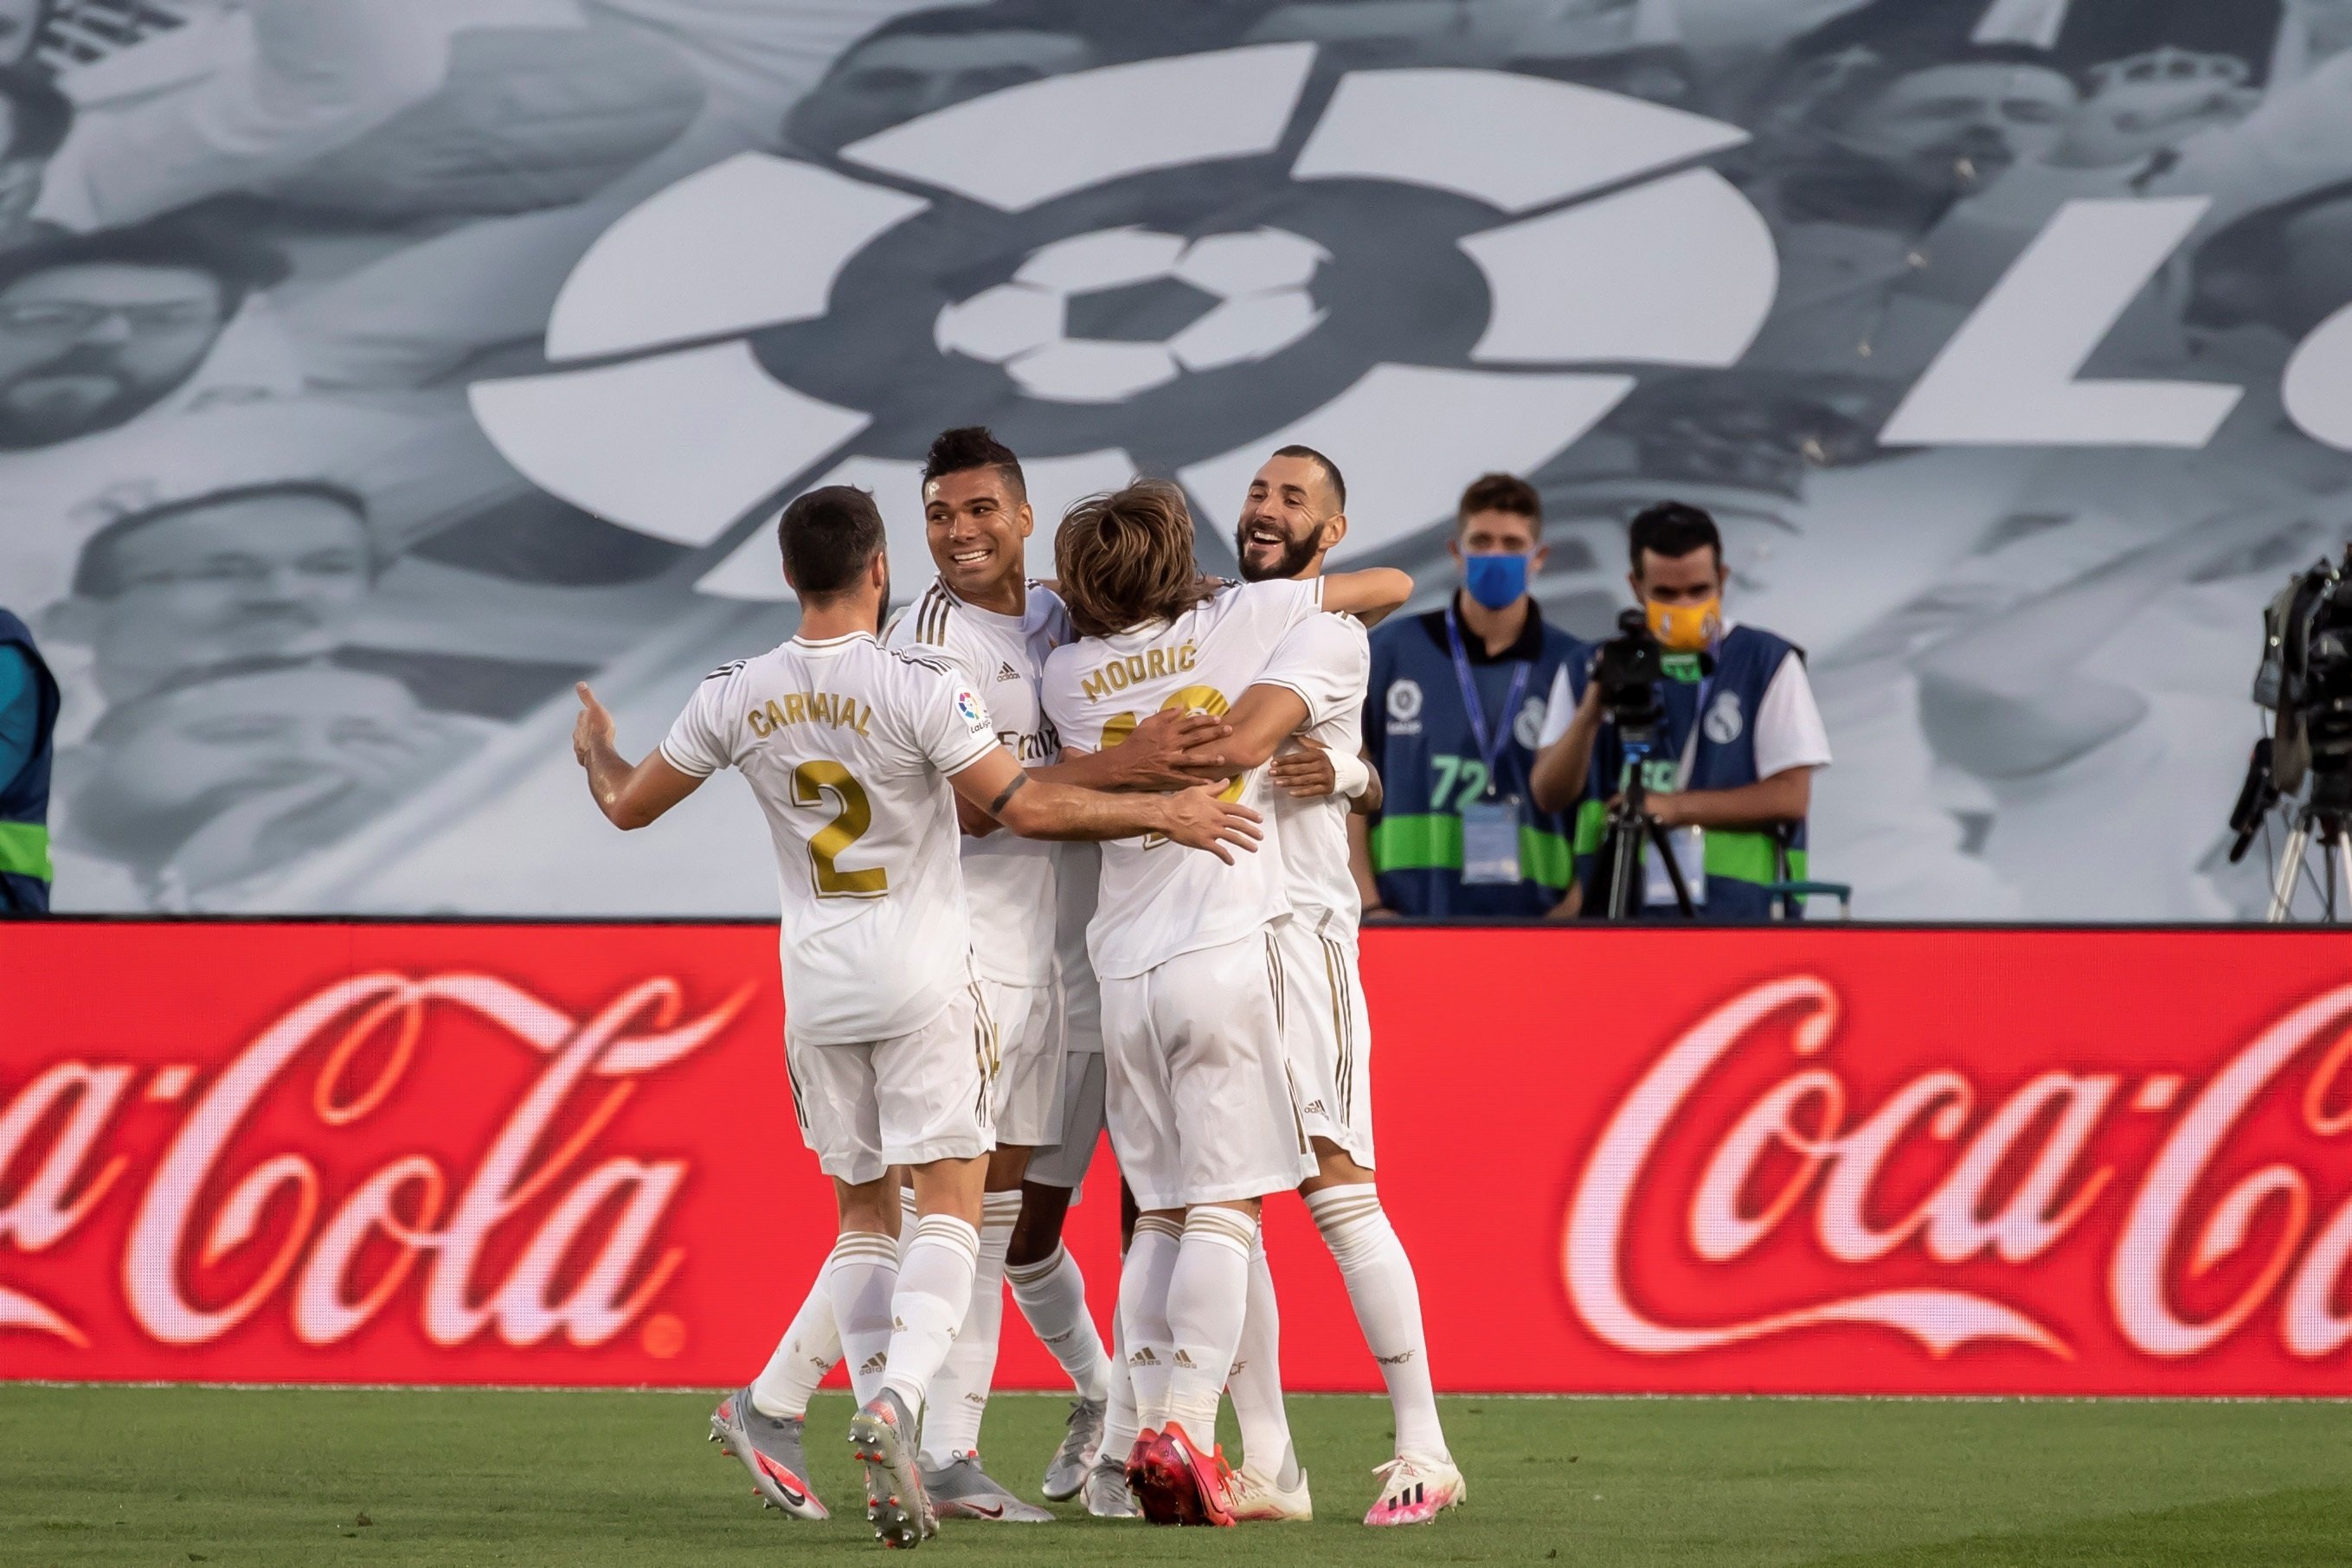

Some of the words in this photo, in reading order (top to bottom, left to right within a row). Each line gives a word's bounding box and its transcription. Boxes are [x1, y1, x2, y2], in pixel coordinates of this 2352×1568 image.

[1081, 639, 1198, 704] MODRIĆ
[748, 691, 872, 739] CARVAJAL
[1430, 755, 1489, 811] 72
[789, 760, 889, 899] 2
